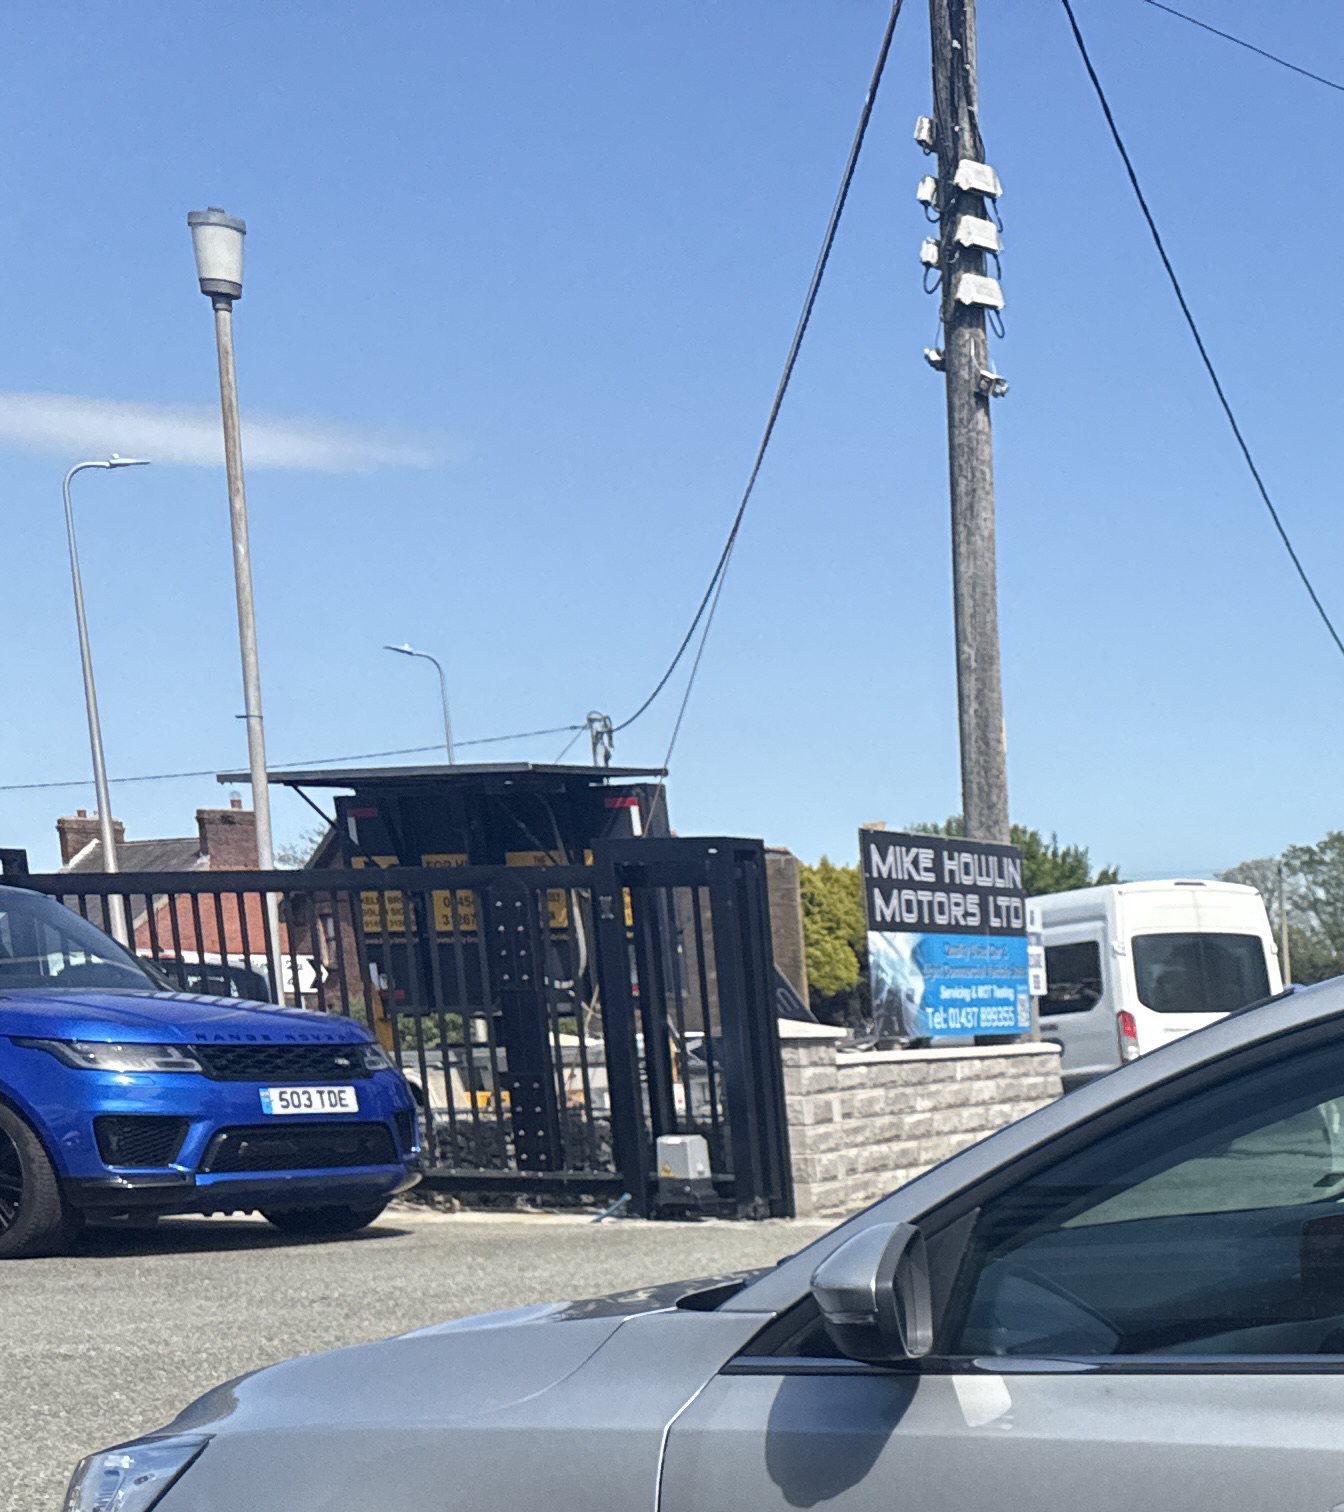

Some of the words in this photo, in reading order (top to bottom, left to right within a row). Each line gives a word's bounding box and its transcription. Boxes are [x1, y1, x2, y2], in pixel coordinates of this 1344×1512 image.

[869, 843, 936, 882] MIKE
[942, 850, 1022, 889] HOWLIN
[873, 887, 981, 927] MOTORS
[989, 895, 1023, 928] LTD
[948, 1006, 979, 1029] 01437
[316, 1089, 349, 1109] TDE
